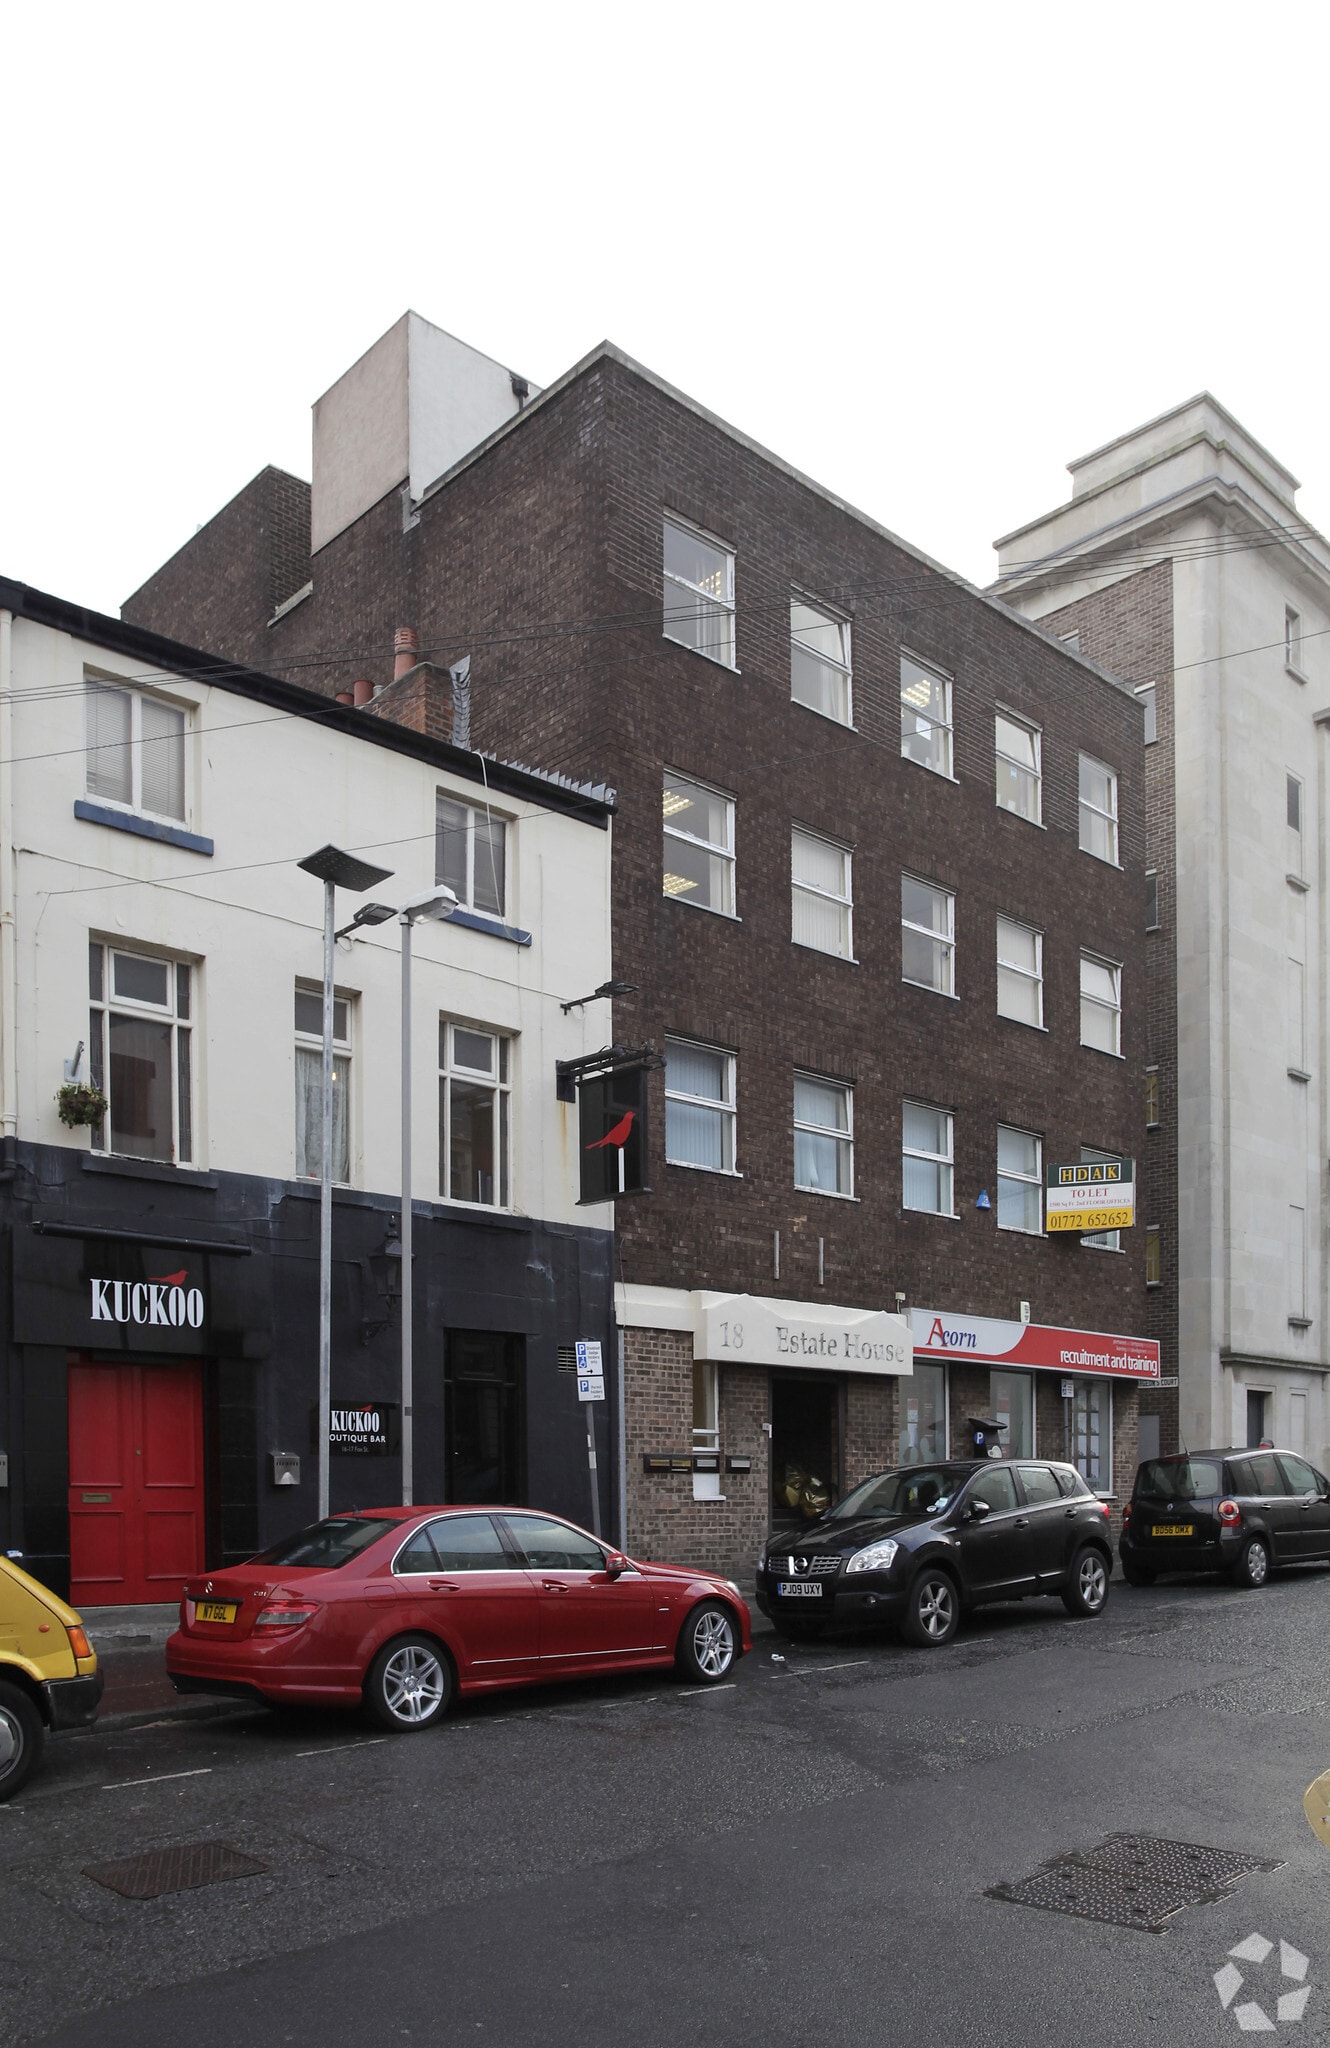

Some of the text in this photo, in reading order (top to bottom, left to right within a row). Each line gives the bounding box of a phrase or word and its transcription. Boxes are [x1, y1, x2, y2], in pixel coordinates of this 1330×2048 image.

[1061, 1166, 1118, 1182] HDAK
[1071, 1187, 1109, 1199] TO LET
[1050, 1211, 1128, 1229] 01772 652652
[90, 1278, 204, 1328] KUCKOO
[925, 1317, 977, 1348] Acorn
[720, 1321, 905, 1363] 18 Estate House
[1060, 1348, 1158, 1376] recruitment and training
[1161, 1378, 1177, 1386] COURT
[331, 1410, 380, 1433] KUCKOO
[329, 1433, 386, 1443] OUTIQUE BAR
[782, 1584, 821, 1595] PJ09 UXY
[202, 1604, 227, 1620] N7 GGL
